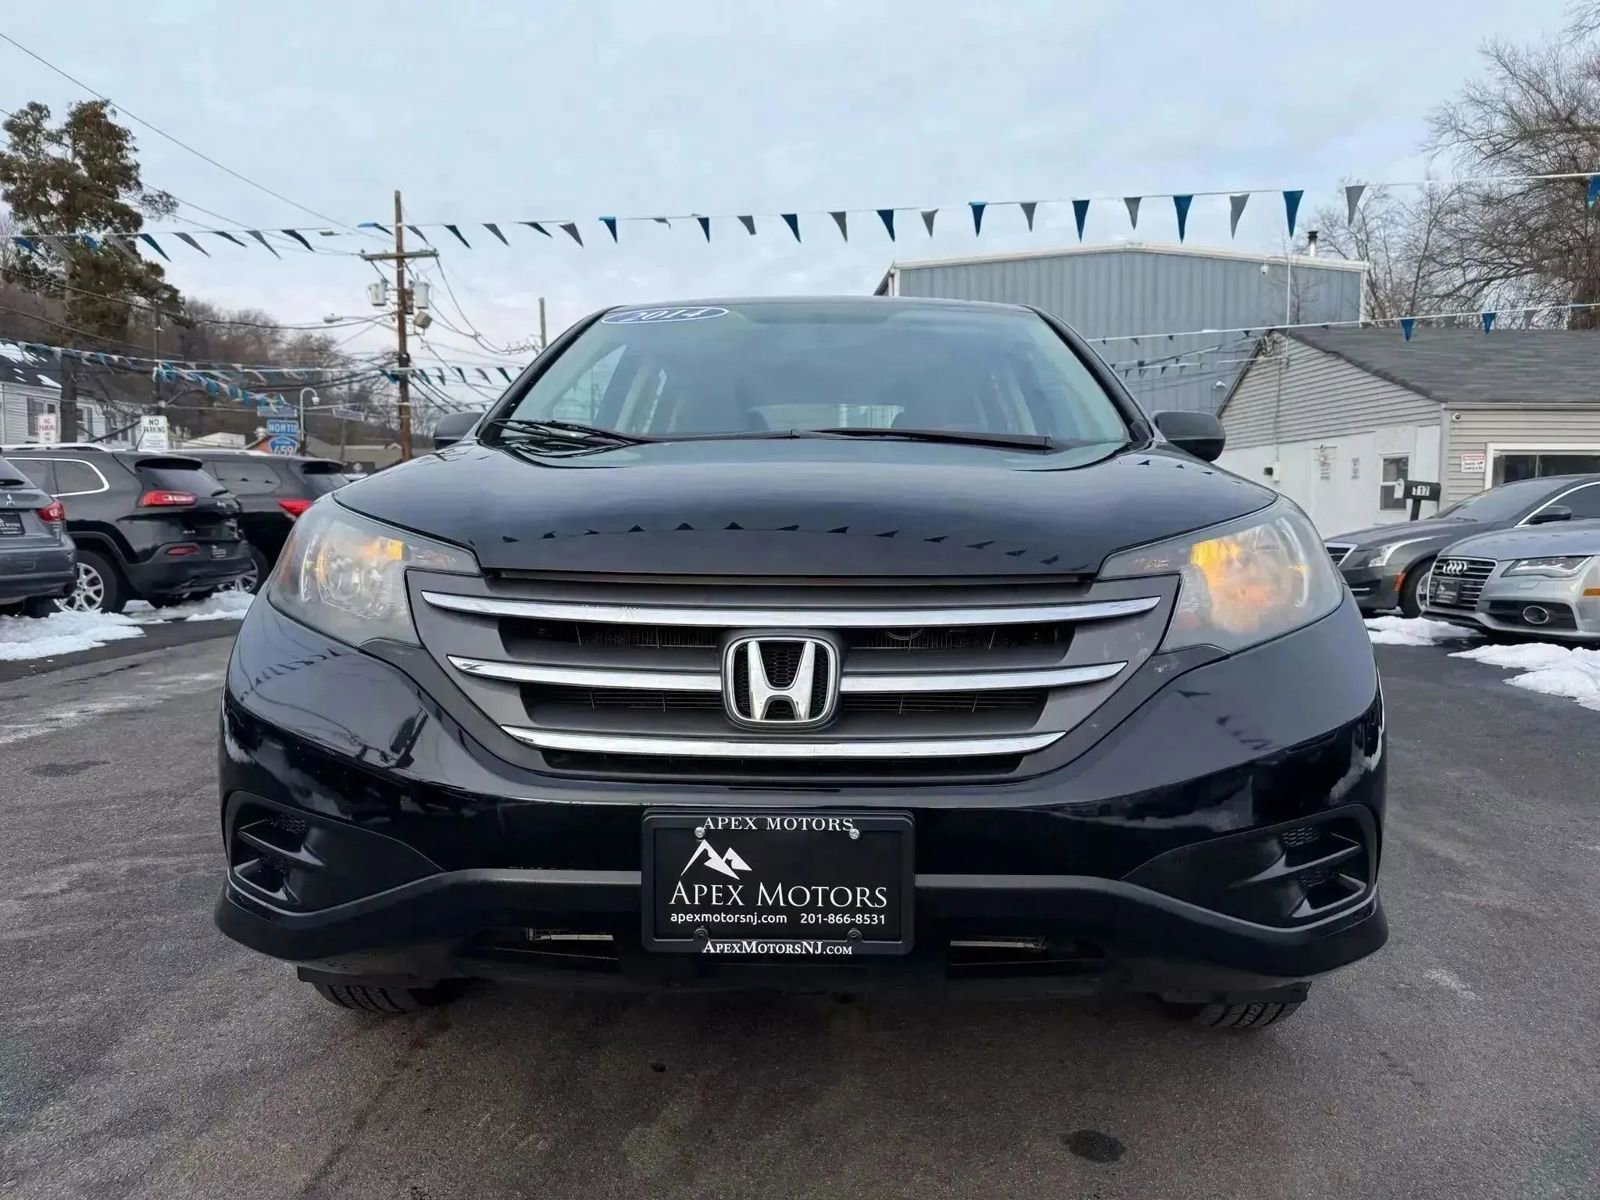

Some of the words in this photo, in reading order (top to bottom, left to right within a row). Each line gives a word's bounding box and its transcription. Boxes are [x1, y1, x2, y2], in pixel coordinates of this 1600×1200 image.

[148, 418, 160, 426] NO
[273, 445, 294, 456] 659
[703, 816, 759, 830] APEX
[766, 817, 853, 831] MOTORS
[668, 880, 745, 906] APEX
[756, 881, 888, 908] MOTORS
[670, 912, 788, 926] apexmotorsnj.com
[800, 913, 886, 925] 201-866-8531
